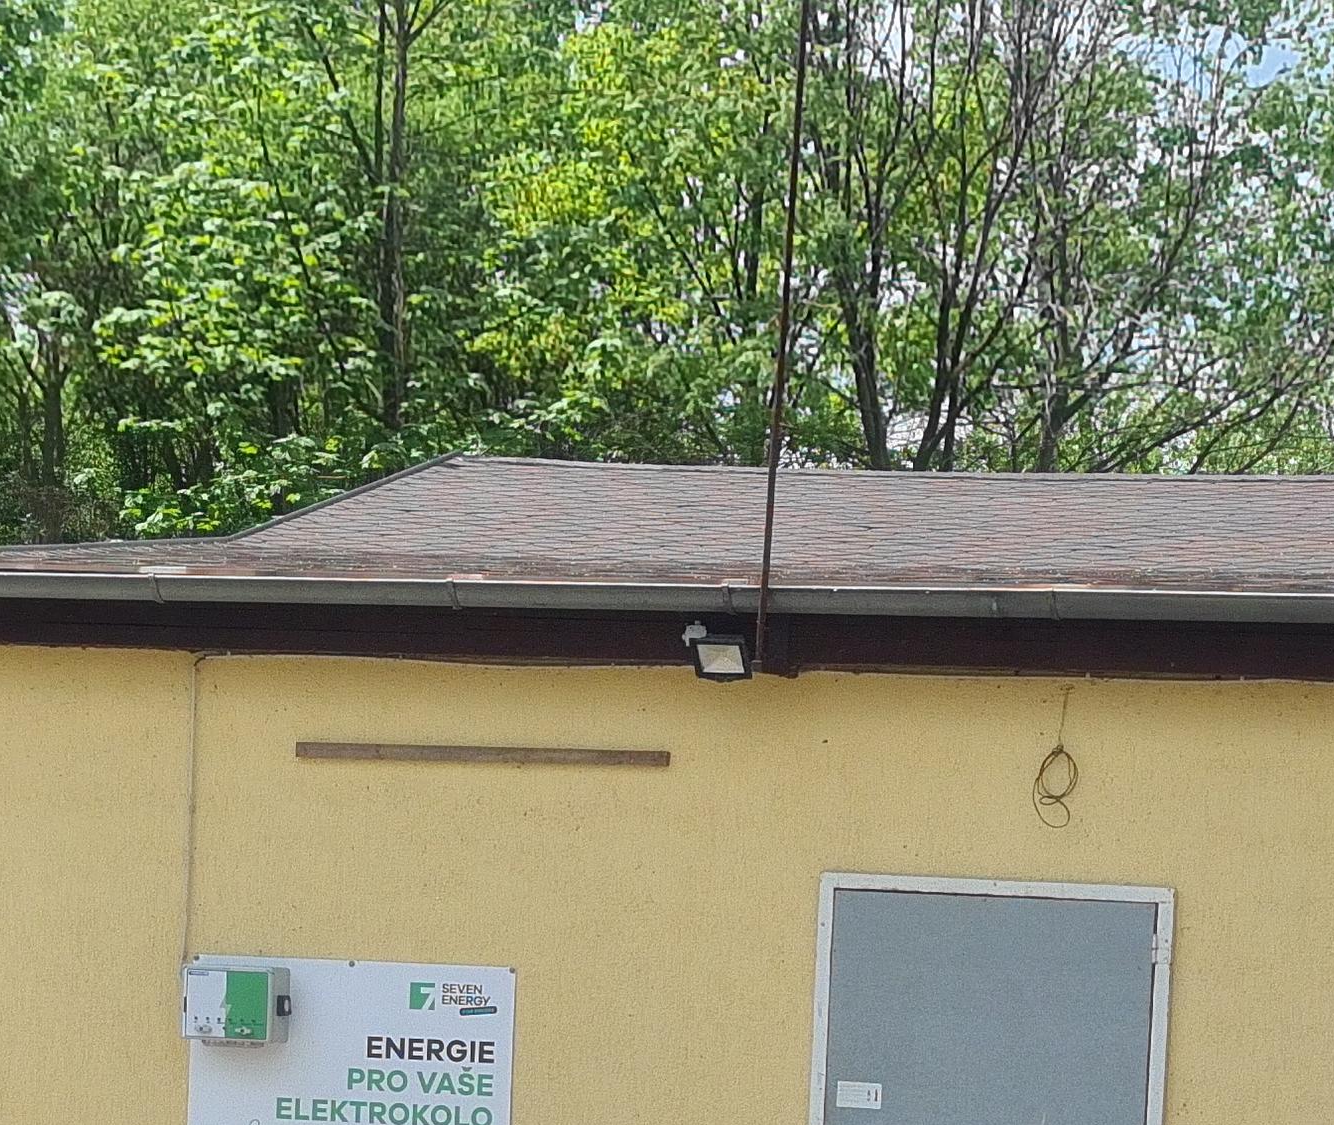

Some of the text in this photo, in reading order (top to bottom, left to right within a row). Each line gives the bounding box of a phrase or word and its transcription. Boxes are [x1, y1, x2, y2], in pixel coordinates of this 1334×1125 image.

[442, 983, 483, 995] SEVEN
[441, 995, 491, 1007] ENERGY
[366, 1036, 496, 1064] ENERGIE
[347, 1066, 494, 1097] PRO VAŠE
